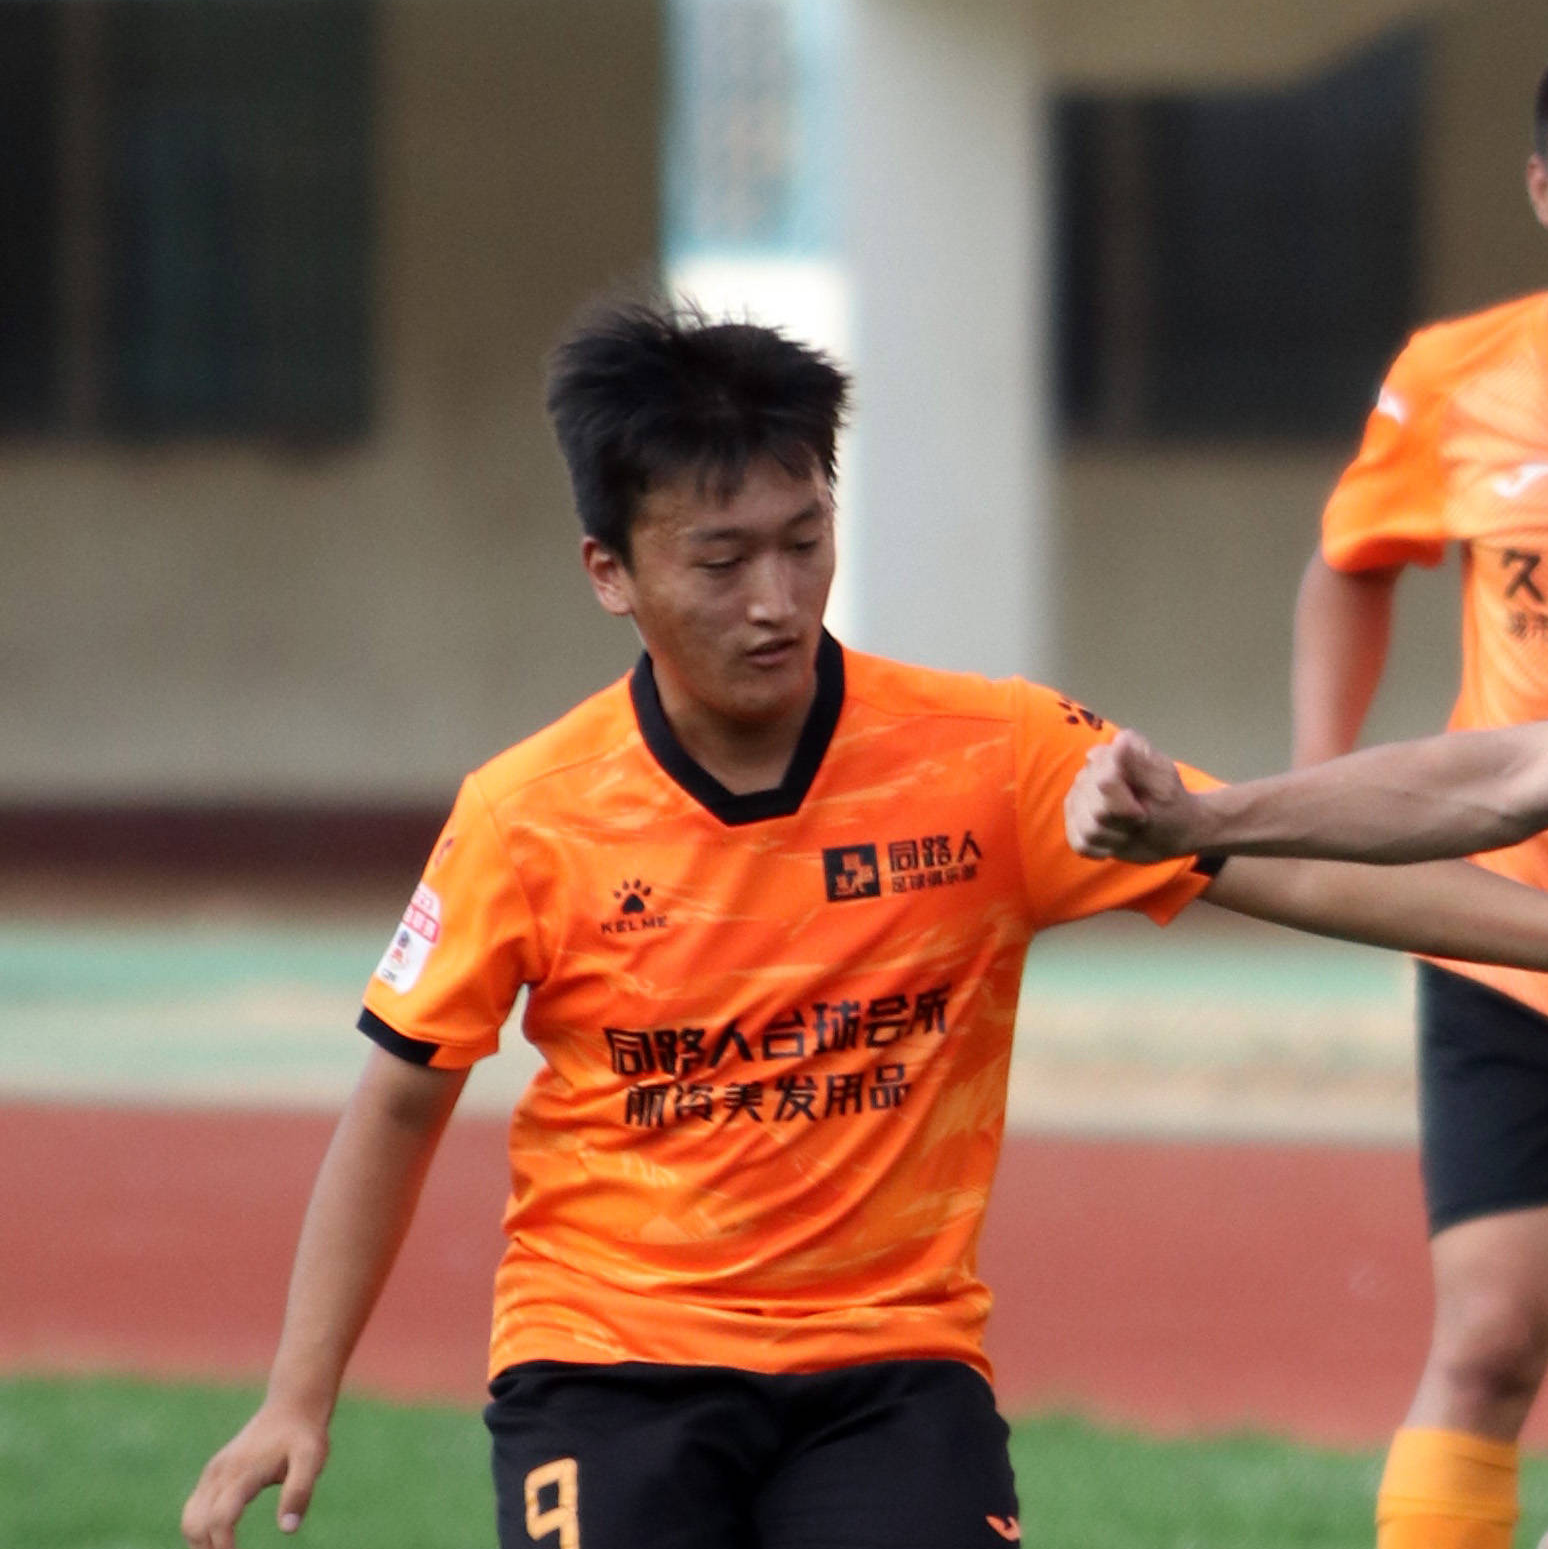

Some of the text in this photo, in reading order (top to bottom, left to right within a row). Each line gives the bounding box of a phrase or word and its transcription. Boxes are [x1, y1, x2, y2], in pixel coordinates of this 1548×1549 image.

[888, 830, 982, 873] 同路人
[601, 915, 667, 934] KELME
[603, 989, 949, 1076] 同路人台球会所
